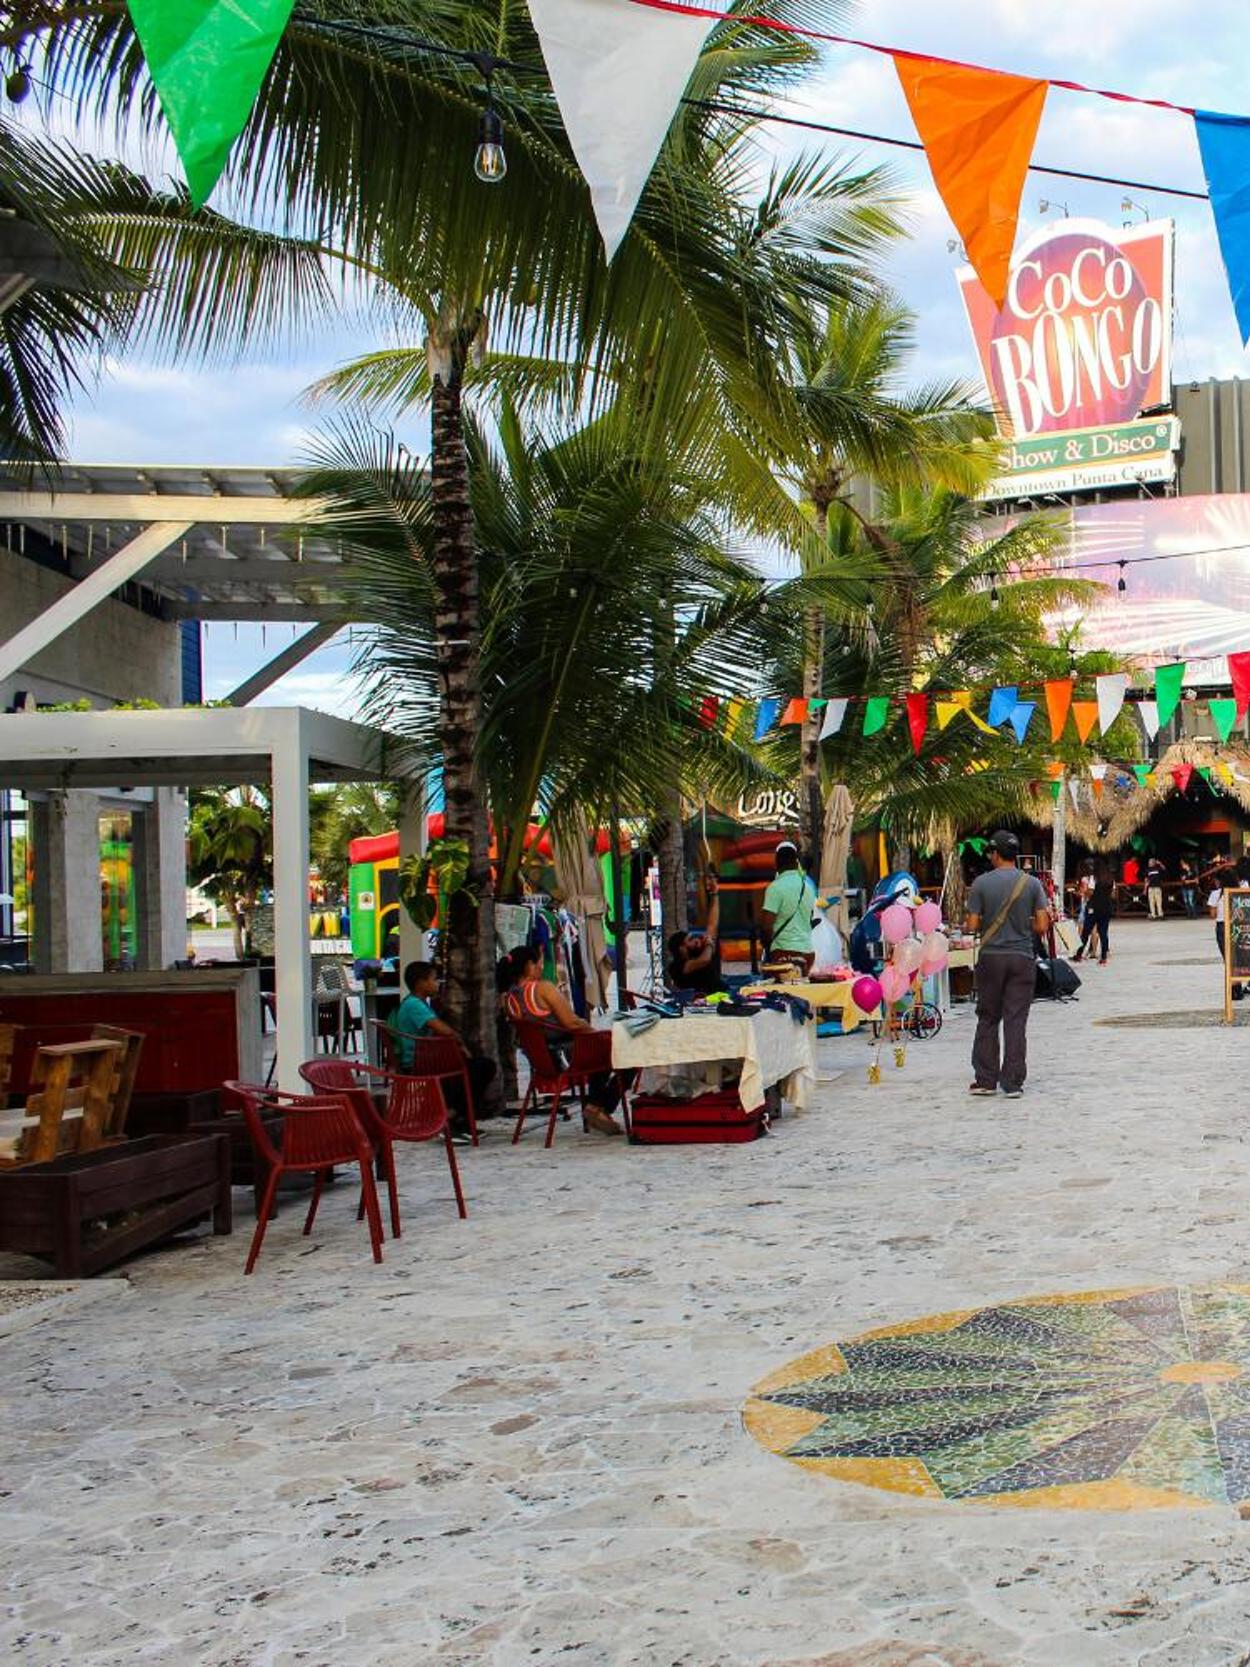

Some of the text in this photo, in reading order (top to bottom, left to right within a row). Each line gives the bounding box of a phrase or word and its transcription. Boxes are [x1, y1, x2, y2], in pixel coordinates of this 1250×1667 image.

[991, 297, 1162, 438] BONGO
[998, 444, 1060, 471] Show
[1064, 438, 1085, 461] &
[984, 478, 1066, 497] Downtown
[1072, 472, 1118, 488] Punta
